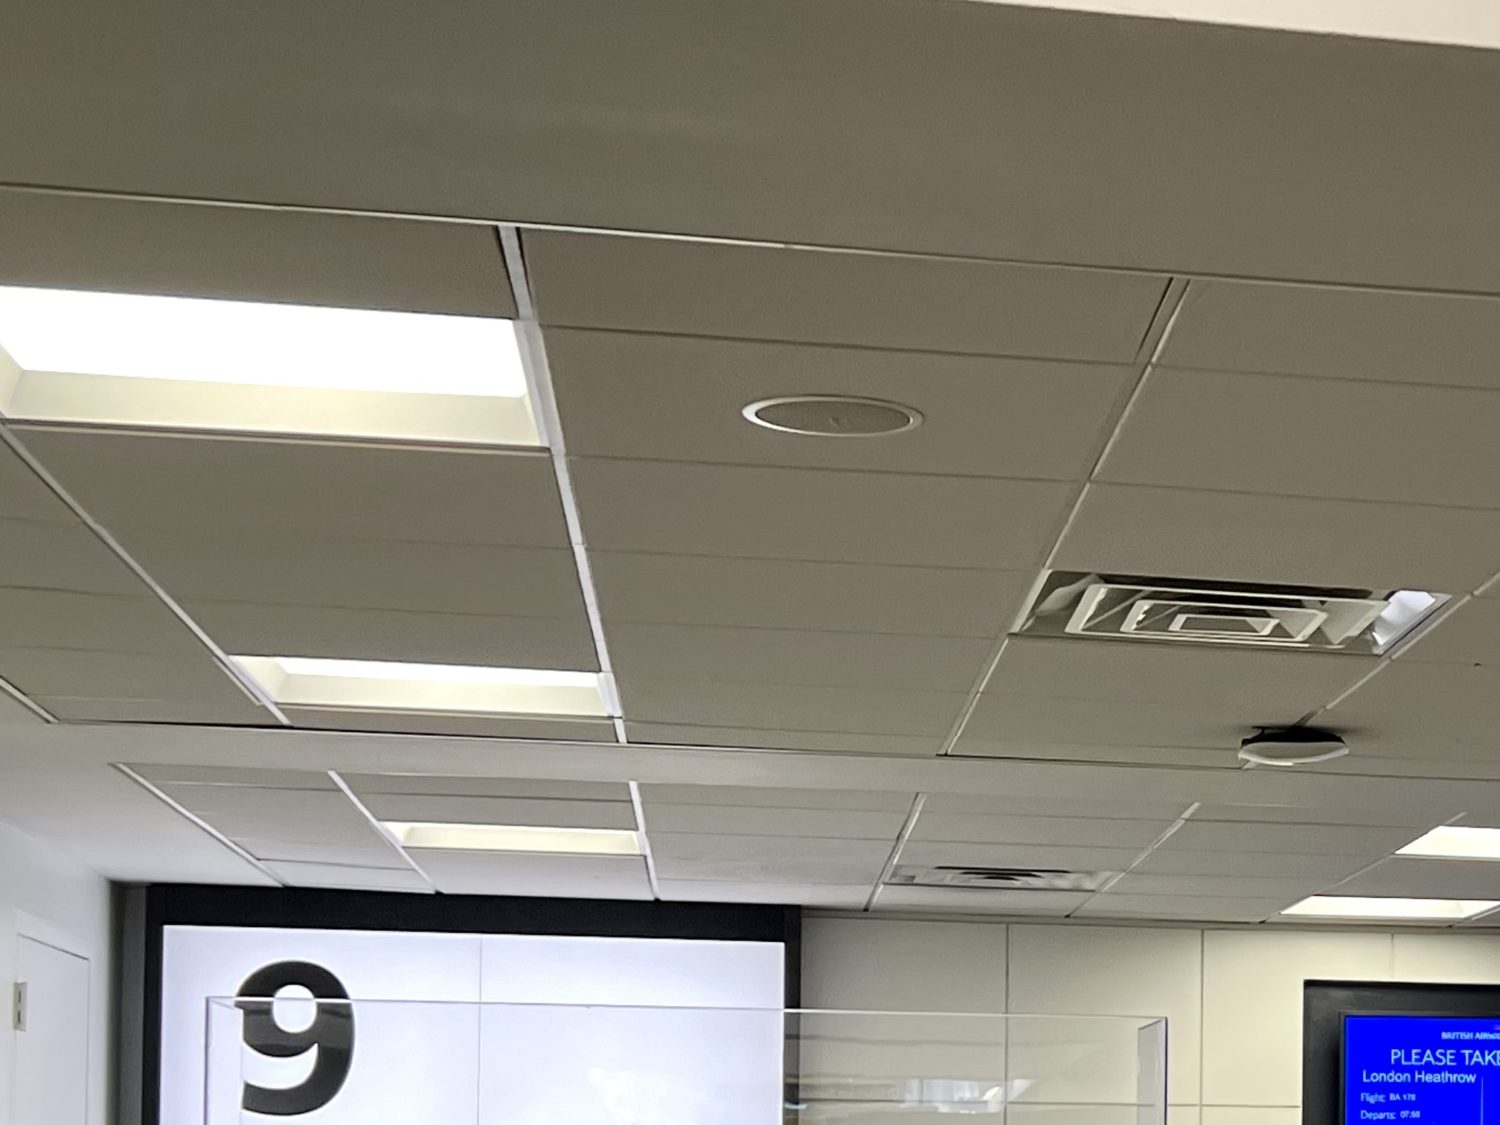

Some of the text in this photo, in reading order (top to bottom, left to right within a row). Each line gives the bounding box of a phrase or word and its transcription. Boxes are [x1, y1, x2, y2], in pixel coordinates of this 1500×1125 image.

[234, 960, 356, 1116] 9
[1391, 1049, 1457, 1066] PLEASE
[1362, 1069, 1477, 1084] London Heathrow
[1389, 1093, 1401, 1101] BA
